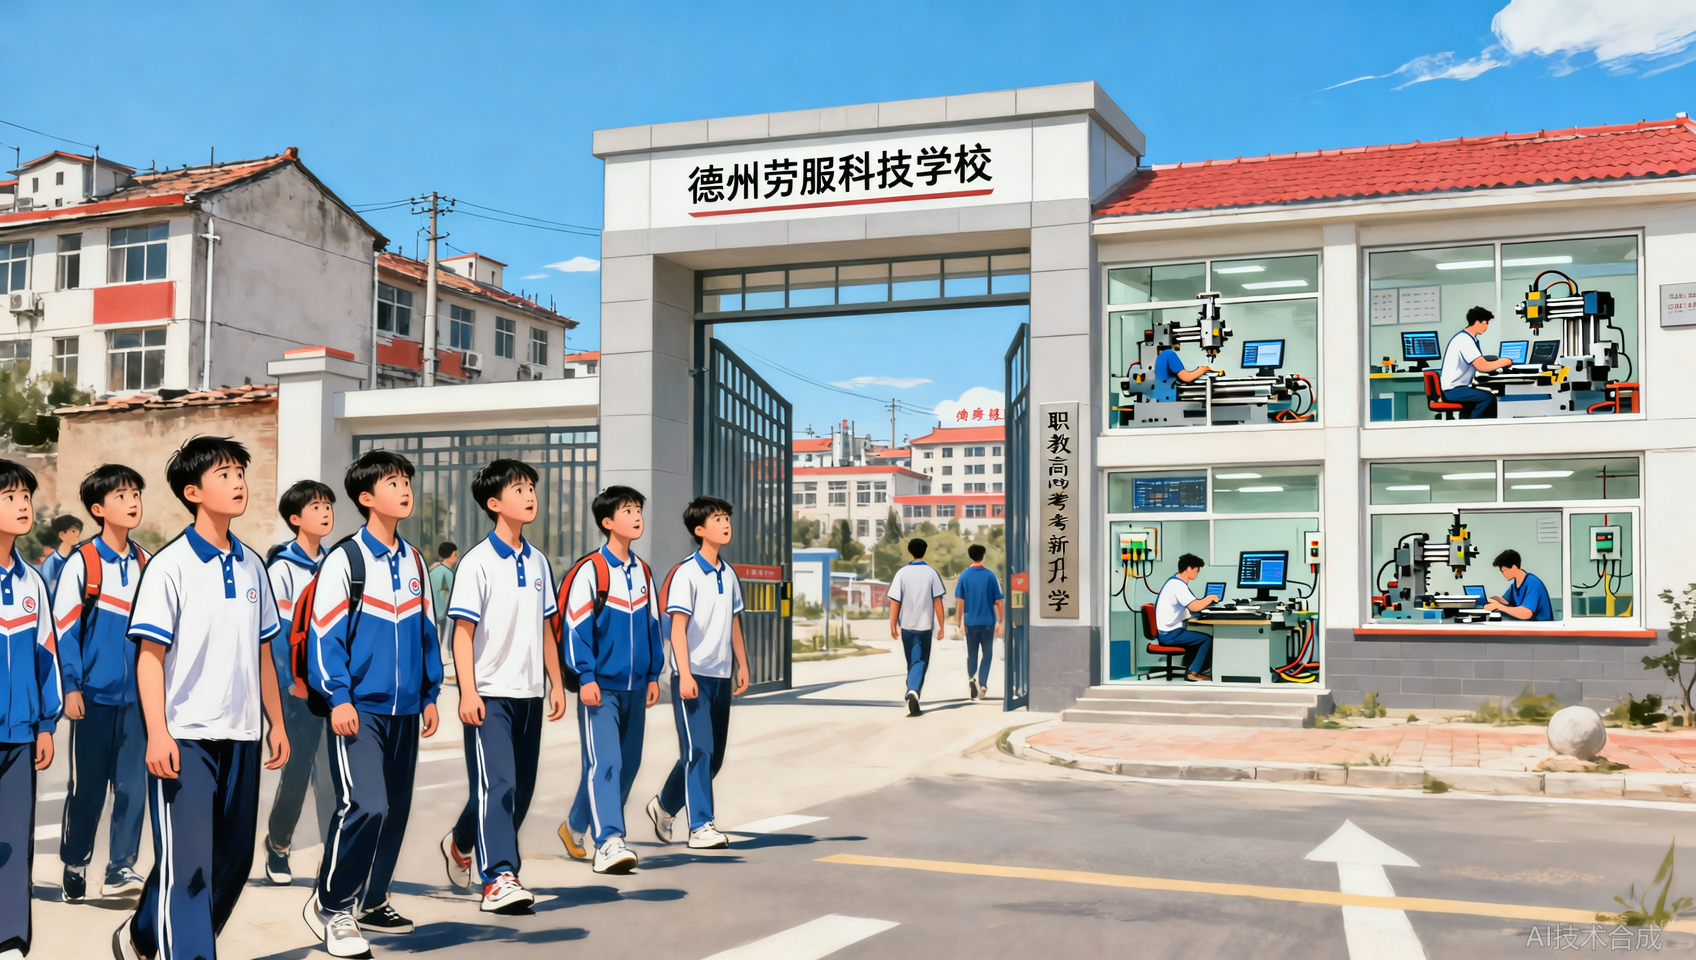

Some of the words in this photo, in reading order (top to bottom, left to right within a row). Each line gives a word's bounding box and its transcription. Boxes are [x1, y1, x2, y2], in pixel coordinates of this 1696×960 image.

[688, 142, 993, 204] 德州劳服科技学校
